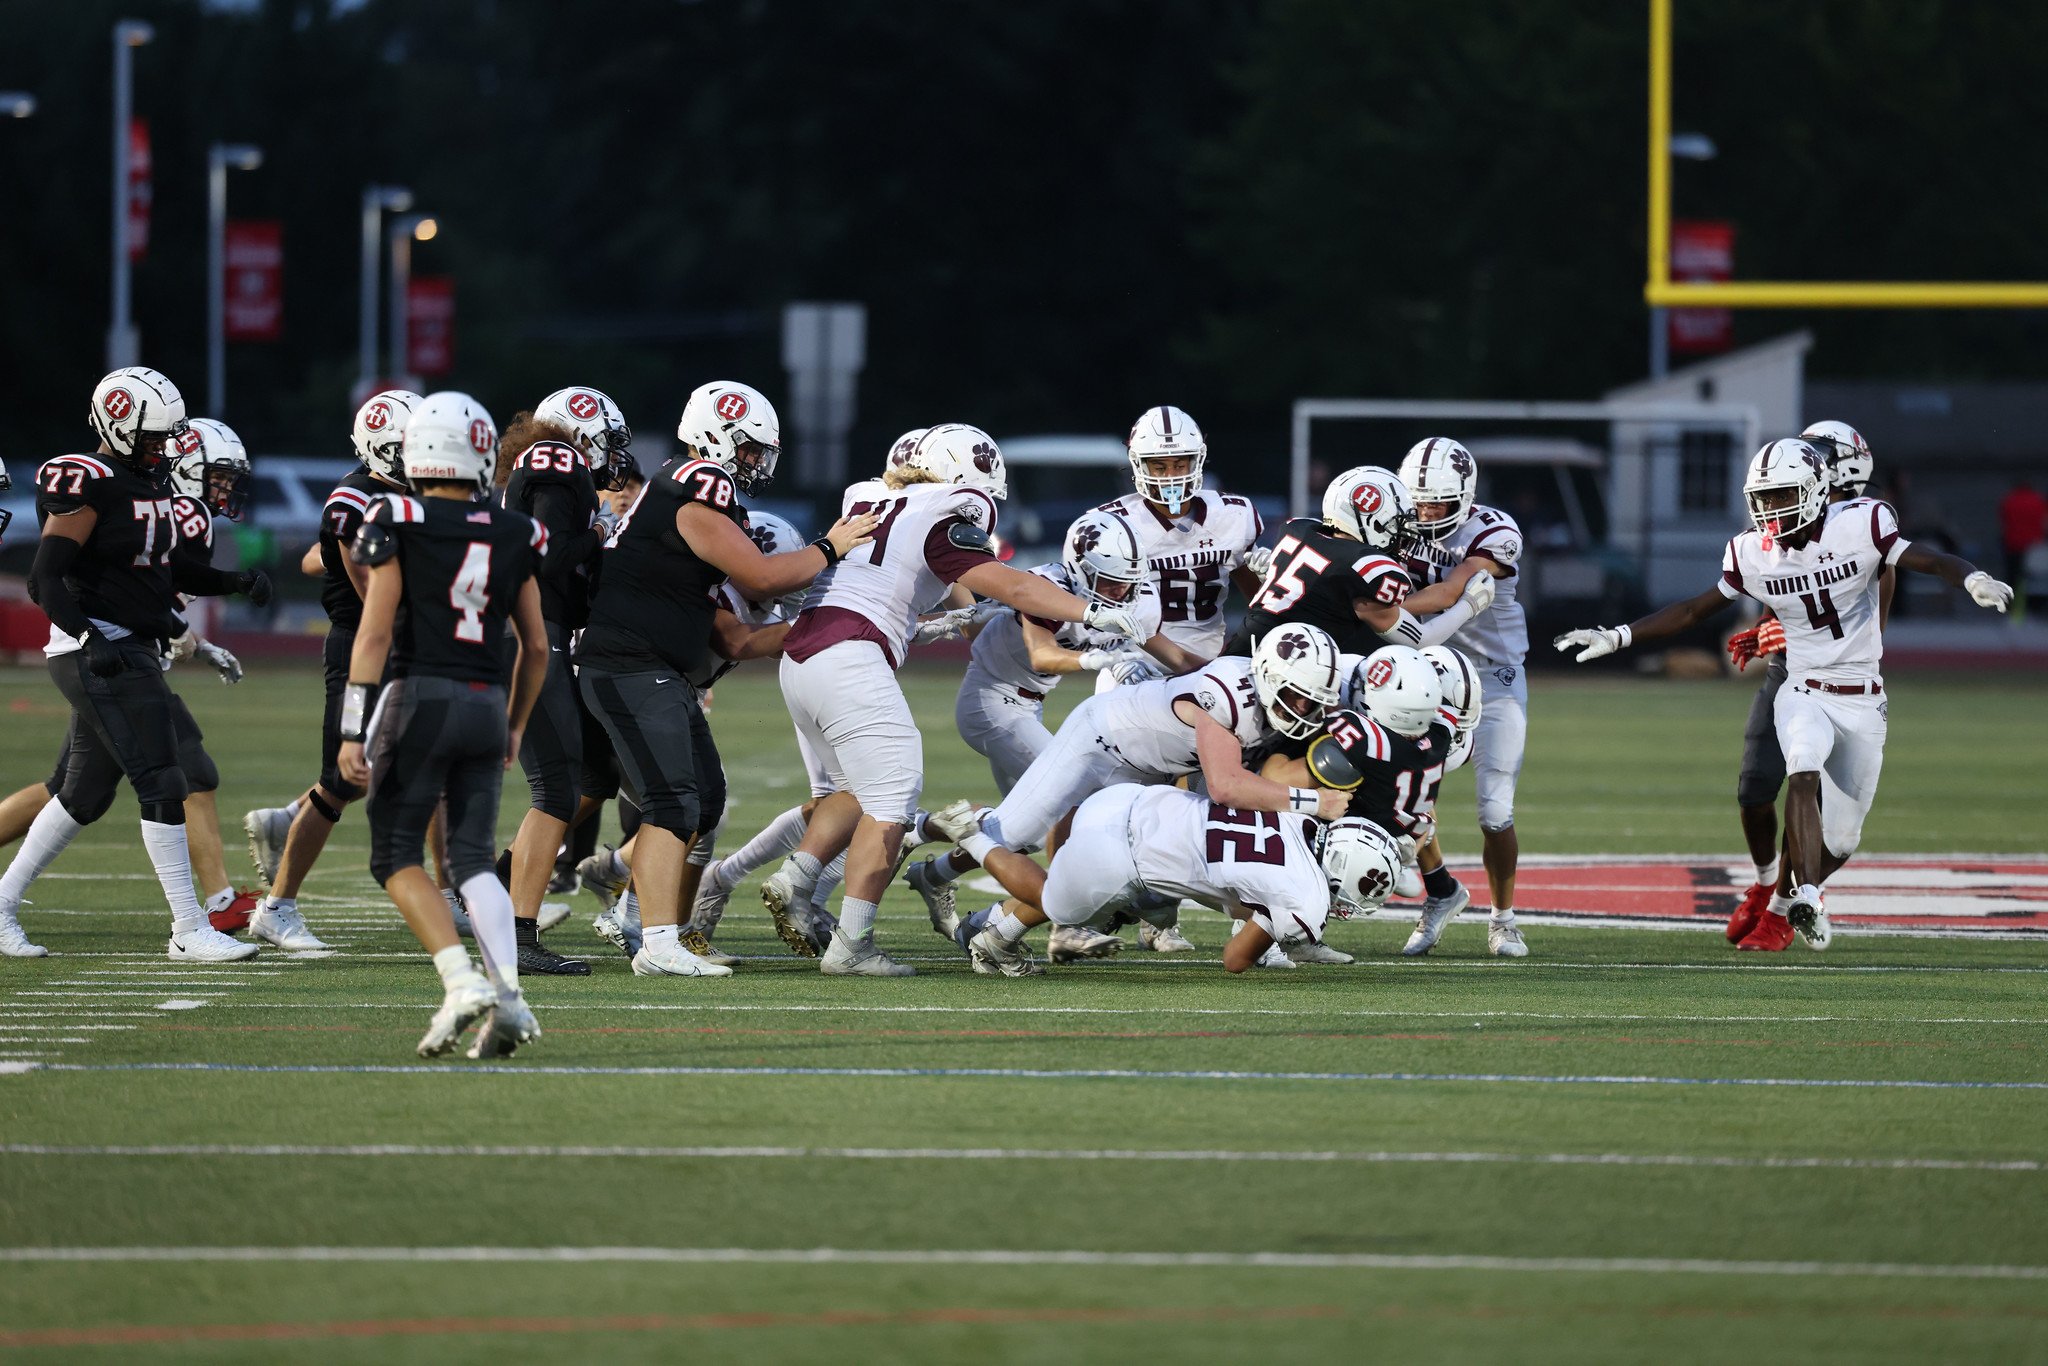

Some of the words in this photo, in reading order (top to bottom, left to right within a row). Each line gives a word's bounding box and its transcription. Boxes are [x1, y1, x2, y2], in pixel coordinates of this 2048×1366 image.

[411, 466, 456, 478] Riddell
[530, 445, 574, 473] 53
[46, 466, 86, 494] 77
[694, 472, 732, 508] 78
[133, 498, 177, 568] 77
[174, 499, 207, 539] 26
[331, 511, 349, 537] 7
[450, 542, 492, 644] 4
[1248, 534, 1331, 614] 55
[1799, 587, 1845, 640] 4
[1327, 716, 1364, 751] 15
[1393, 762, 1444, 837] 15
